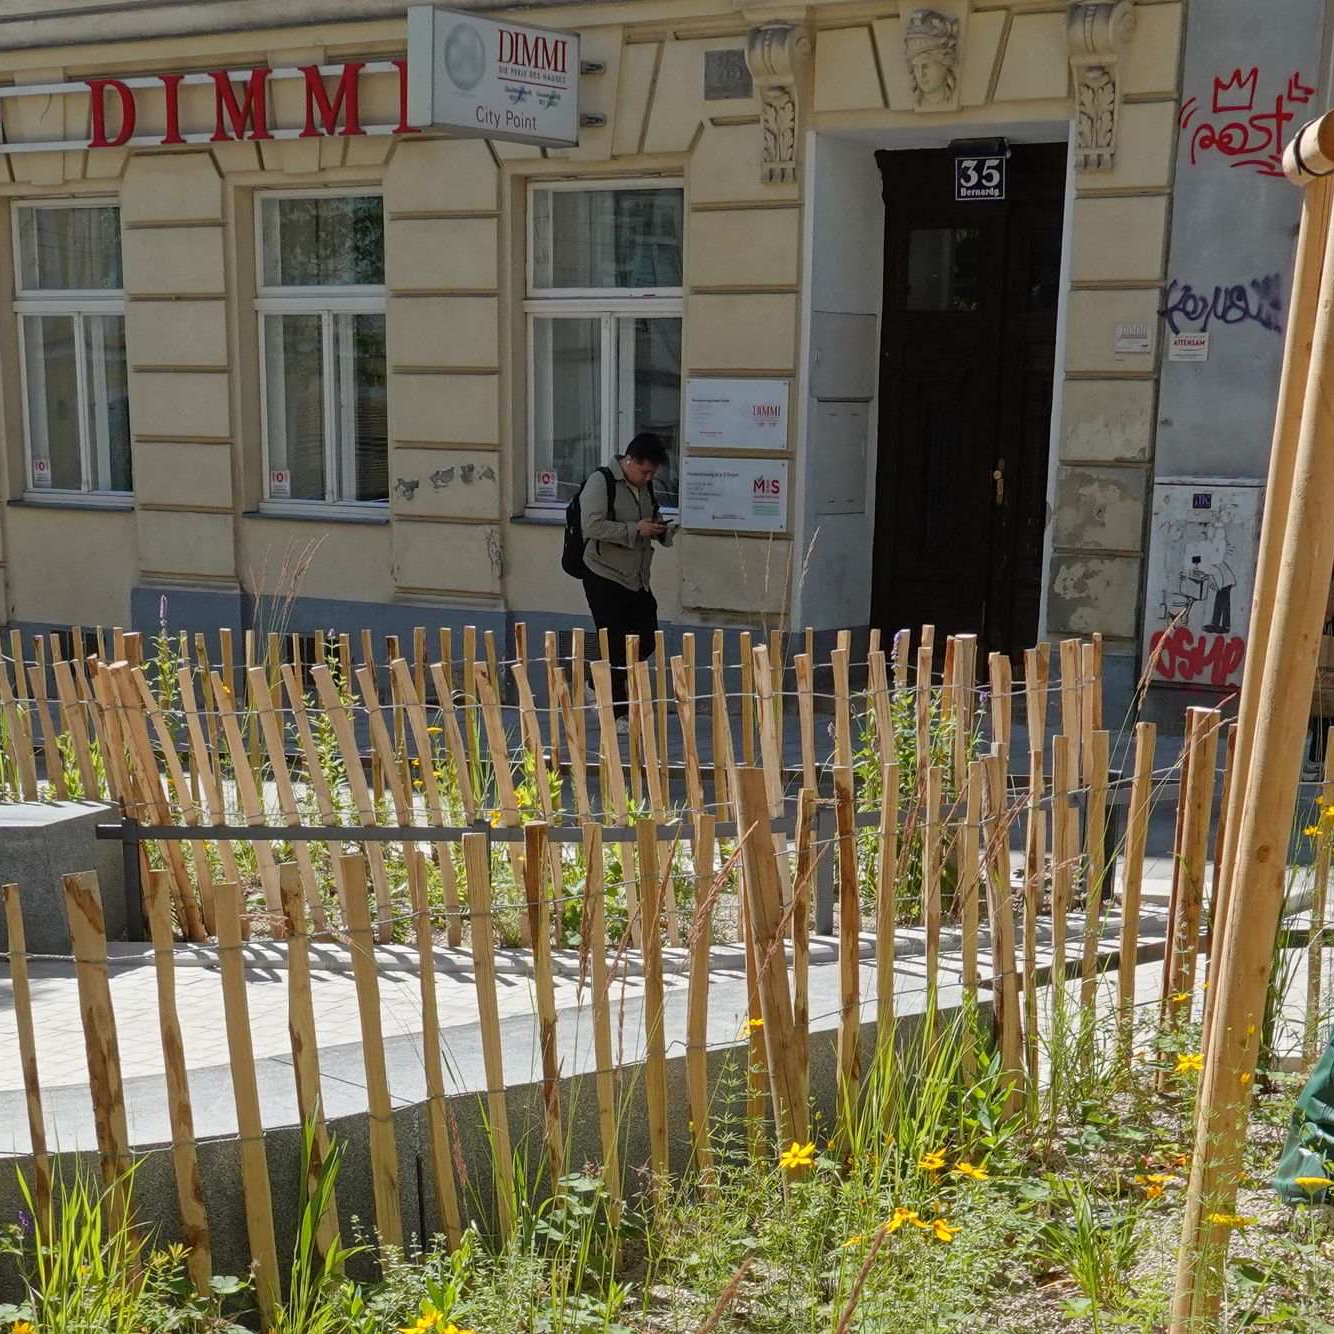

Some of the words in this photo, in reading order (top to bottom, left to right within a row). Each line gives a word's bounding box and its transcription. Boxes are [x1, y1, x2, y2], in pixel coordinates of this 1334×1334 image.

[497, 28, 568, 74] DIMMI
[84, 60, 421, 149] DIMMI
[475, 105, 501, 129] City
[505, 110, 538, 131] Point
[960, 159, 1001, 187] 35
[960, 187, 1000, 197] Bernardg.
[1173, 338, 1206, 347] ATTENSAM
[752, 405, 781, 417] DIMMI
